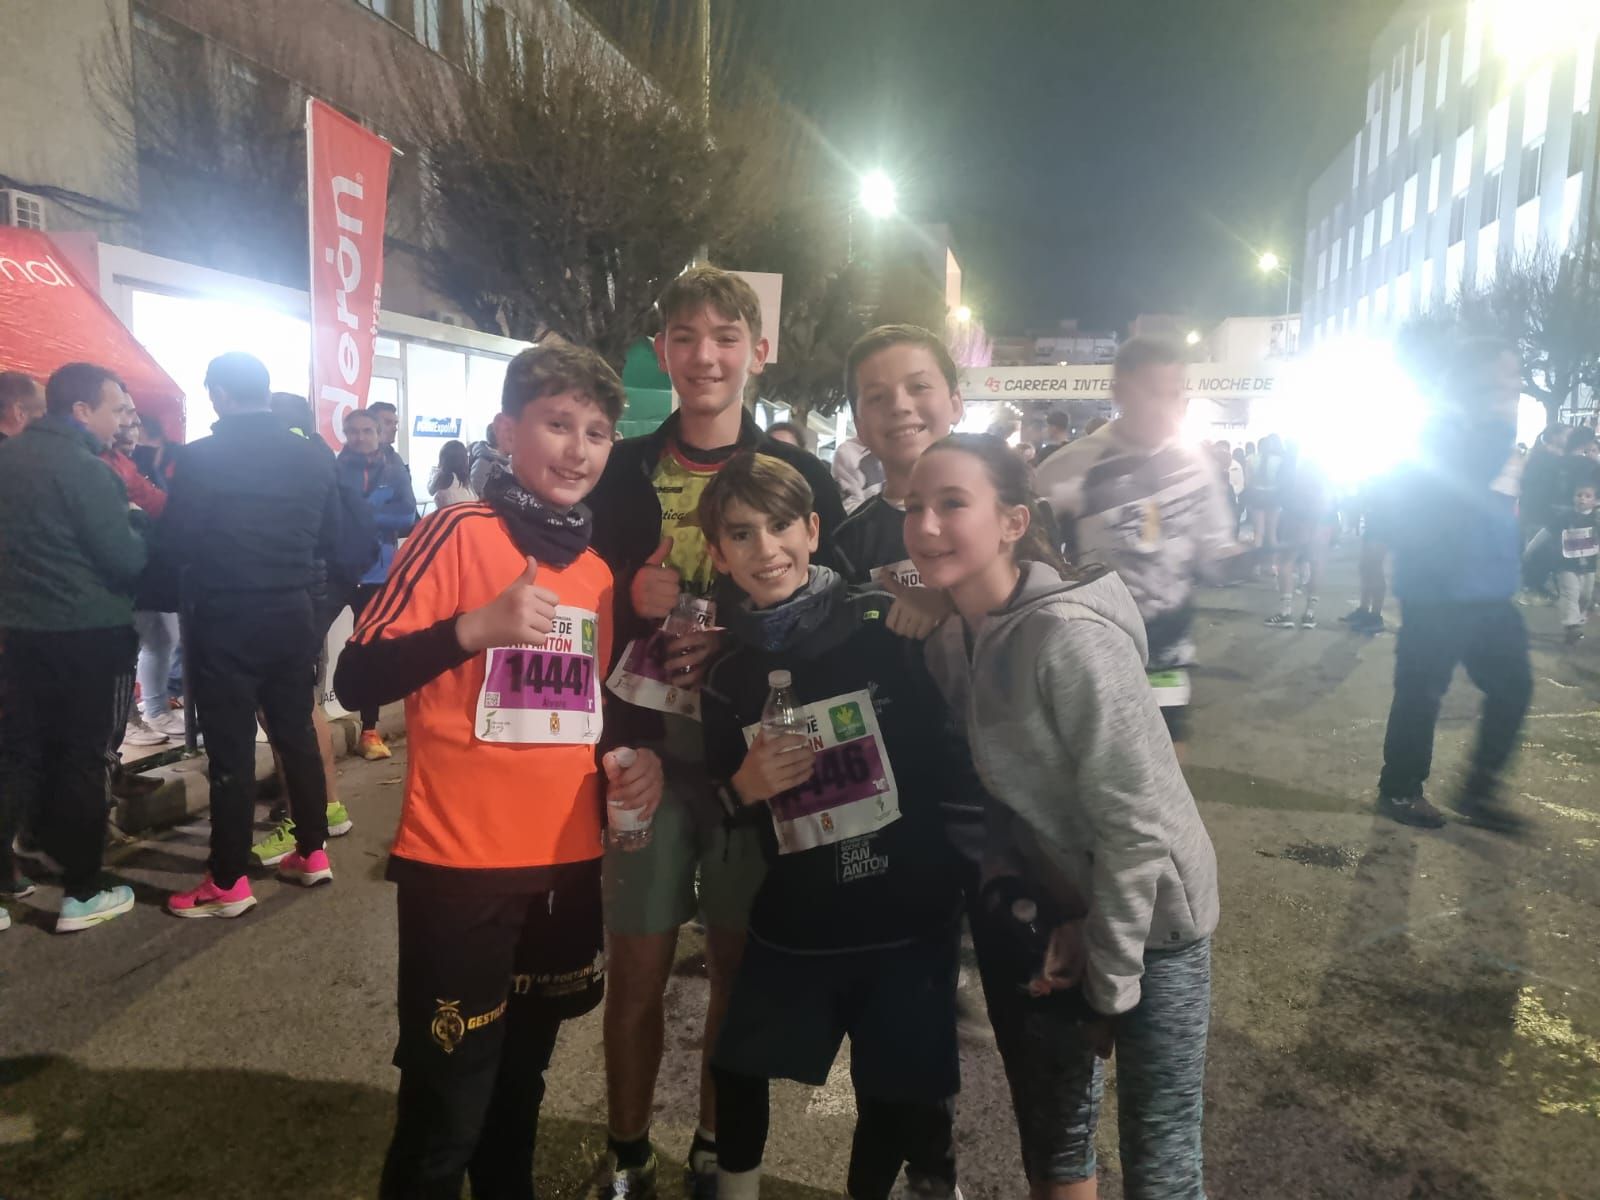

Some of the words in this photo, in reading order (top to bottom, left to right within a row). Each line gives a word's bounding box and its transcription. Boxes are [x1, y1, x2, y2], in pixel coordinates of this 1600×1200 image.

[1004, 379, 1067, 391] CARRERA
[1198, 378, 1251, 391] NOCHE
[1253, 378, 1274, 390] DE
[558, 622, 572, 635] DE
[841, 846, 870, 865] SAN
[842, 854, 889, 879] ANTÓN
